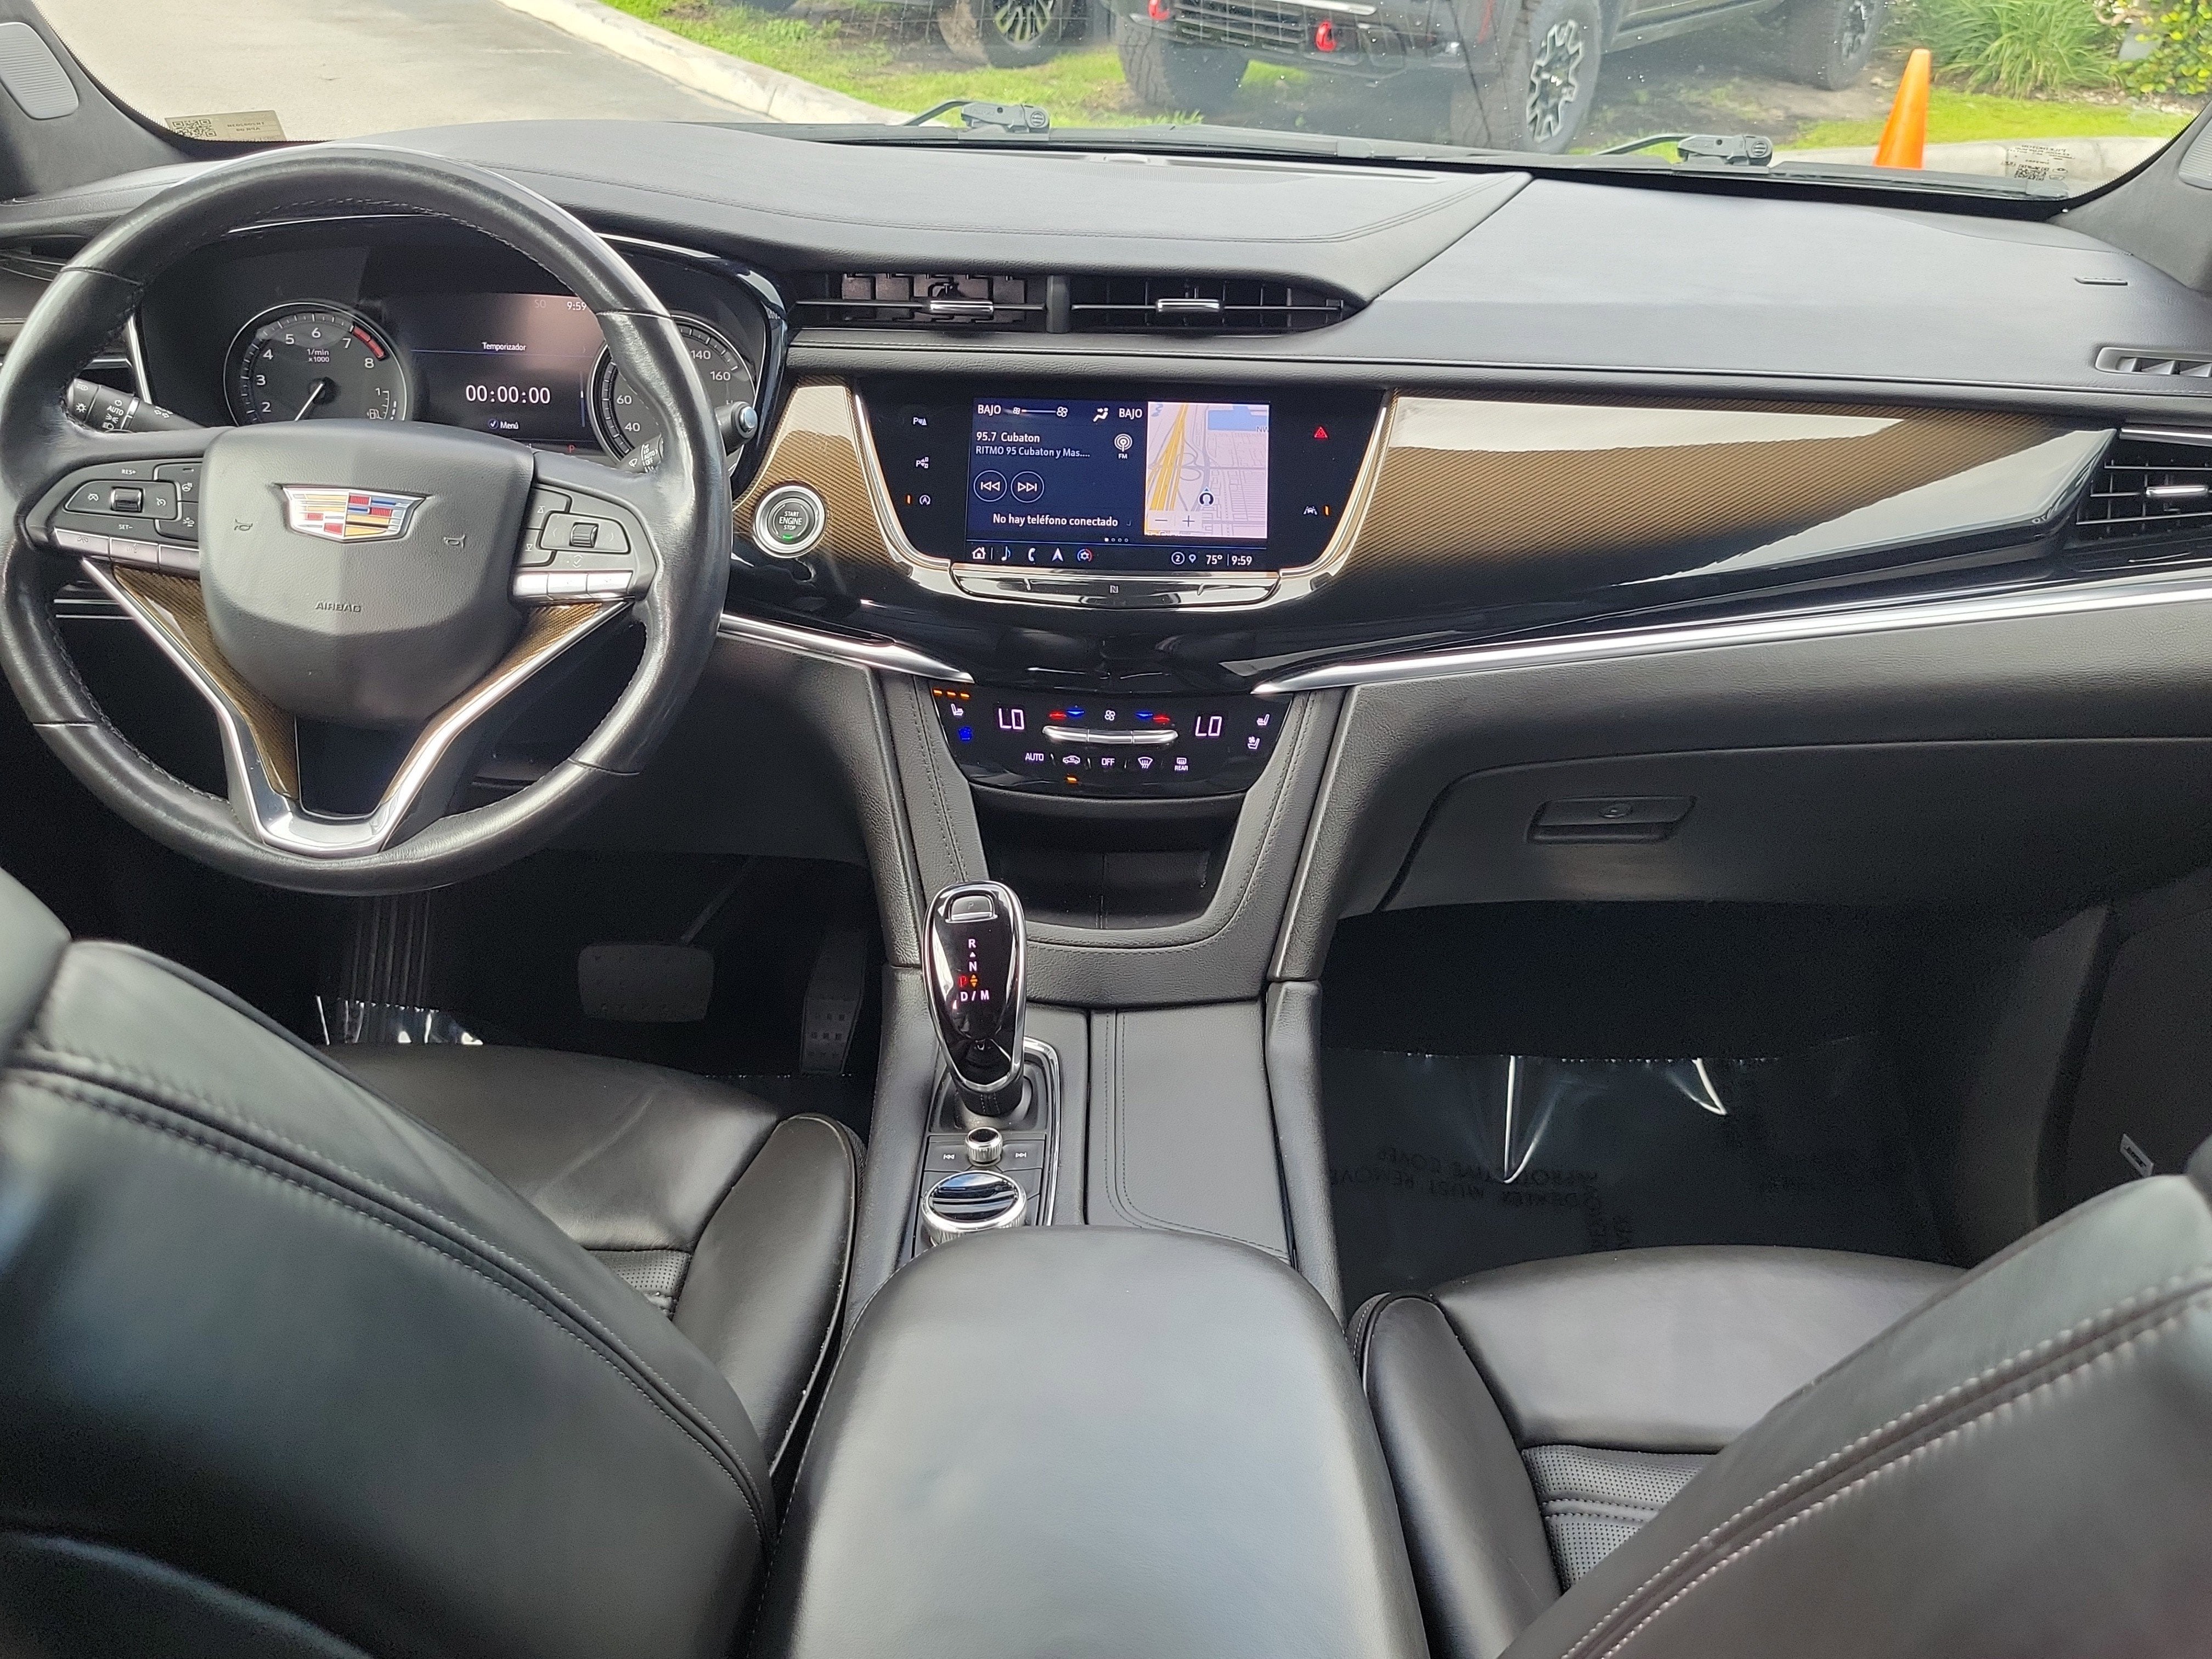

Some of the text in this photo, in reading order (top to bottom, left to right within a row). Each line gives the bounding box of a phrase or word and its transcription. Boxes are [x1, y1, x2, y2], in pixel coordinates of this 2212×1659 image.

[567, 302, 586, 311] 9:59
[312, 328, 321, 338] 6
[285, 334, 294, 345] 5
[342, 338, 351, 348] 7
[482, 342, 526, 351] Temporizador
[263, 349, 273, 360] 4
[691, 350, 711, 360] 140
[364, 358, 374, 369] 8
[256, 375, 266, 385] 3
[710, 371, 731, 381] 160
[466, 385, 550, 404] 00:00:00
[617, 396, 632, 404] 60
[106, 405, 124, 416] AUTO
[262, 402, 272, 413] 2
[978, 404, 1001, 416] BAJO
[1119, 408, 1142, 420] BAJO
[500, 421, 518, 430] Menú
[624, 422, 640, 432] 40
[977, 432, 1040, 443] 95.7 Cubaton
[644, 450, 655, 460] AUTO
[975, 446, 1004, 455] RITMO
[1006, 447, 1017, 455] 95
[1018, 447, 1054, 456] Cubaton
[1056, 450, 1061, 459] y
[779, 517, 803, 525] ENGINE
[993, 514, 1118, 526] No hay teléfono conectado
[1206, 555, 1223, 565] 75°
[1232, 556, 1252, 566] 9:59
[315, 602, 362, 613] AIRBAG
[998, 708, 1025, 730] LO
[1195, 716, 1222, 736] LO
[1025, 753, 1044, 761] AUTO
[968, 939, 976, 948] R
[969, 961, 977, 972] N
[959, 976, 967, 987] P
[961, 991, 968, 1002] D
[980, 990, 989, 1000] M
